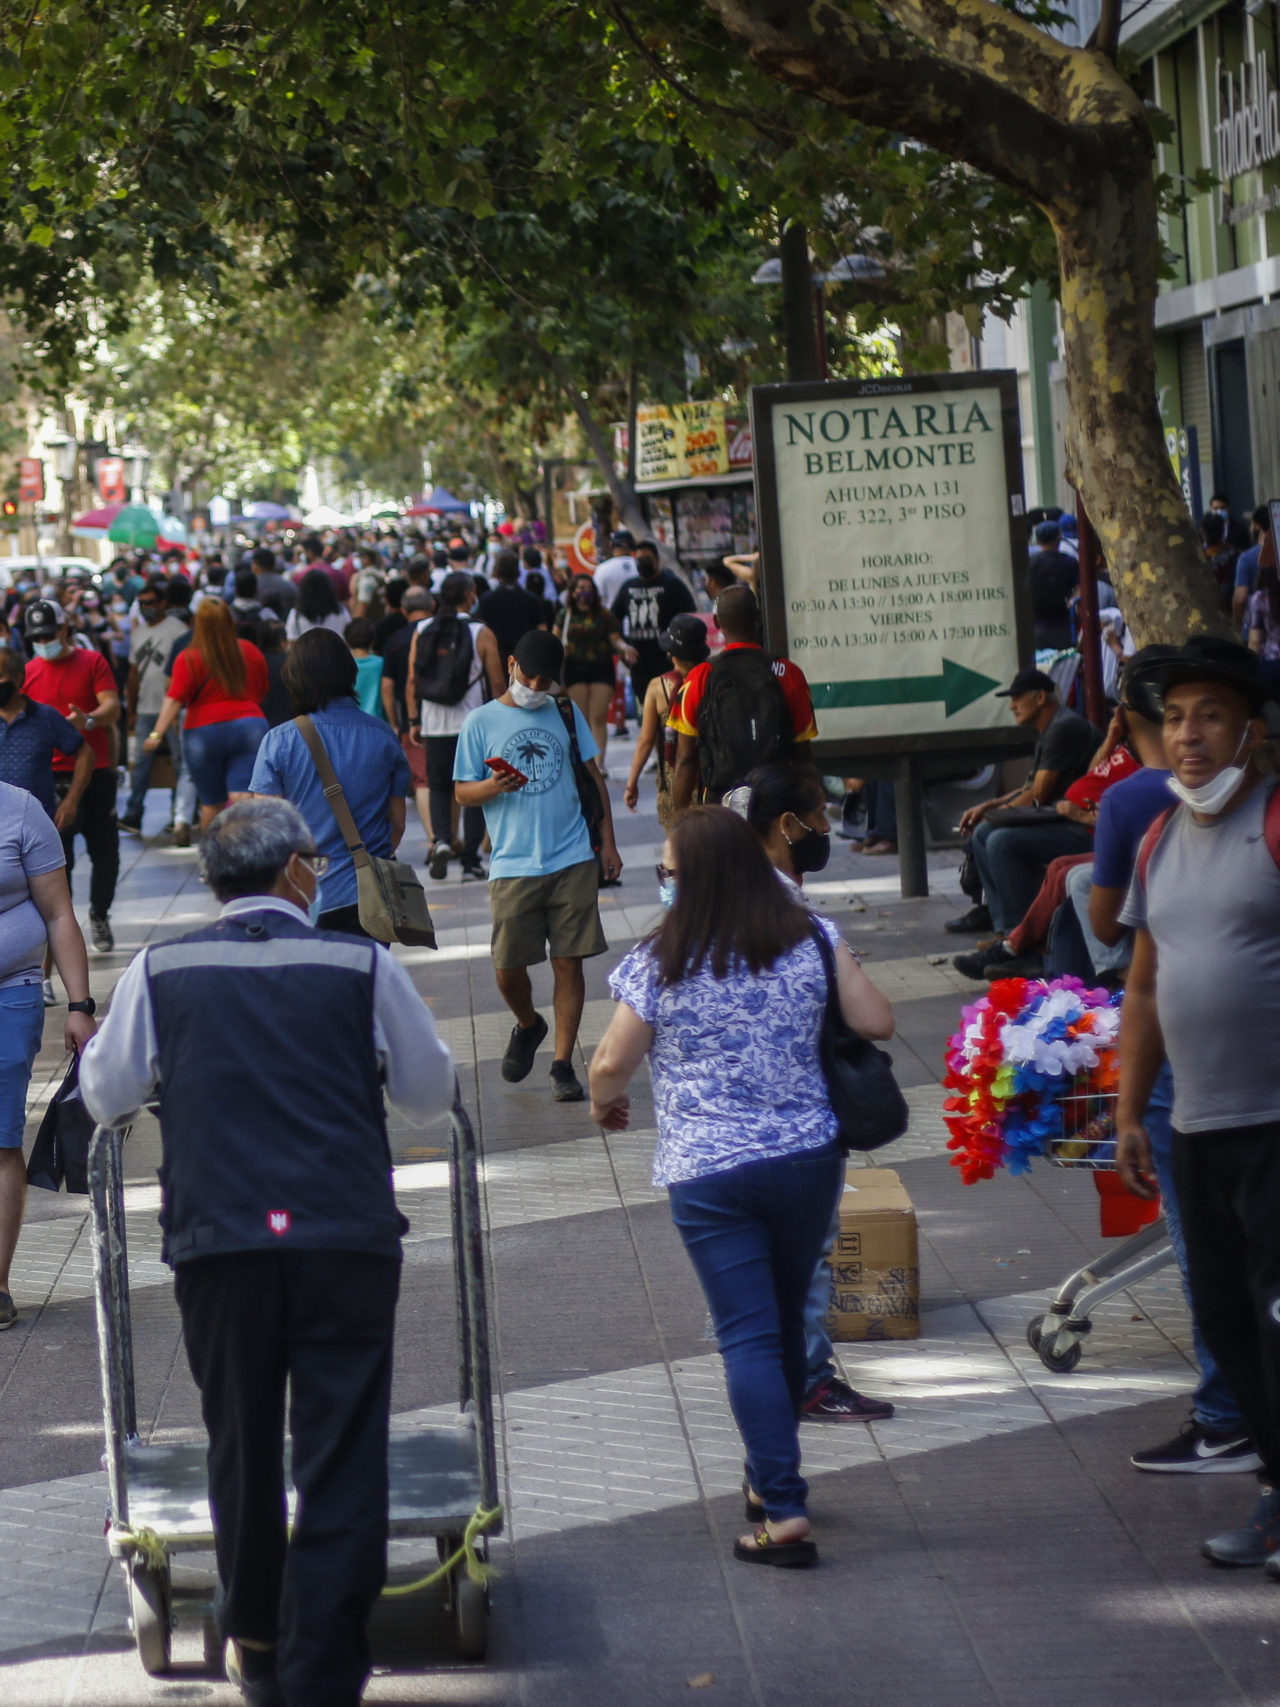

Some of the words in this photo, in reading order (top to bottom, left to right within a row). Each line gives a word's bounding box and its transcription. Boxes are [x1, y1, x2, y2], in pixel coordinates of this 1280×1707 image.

[857, 383, 913, 395] JCDecaux
[782, 399, 995, 446] NOTARIA
[804, 441, 976, 475] BELMONTE
[824, 482, 927, 504] AHUMADA
[933, 479, 961, 496] 131
[822, 510, 852, 527] OF.
[858, 507, 893, 525] 322,
[923, 502, 967, 520] PISO
[862, 551, 933, 568] HORARIO:
[829, 579, 848, 593] DE
[851, 575, 900, 591] LUNES
[903, 575, 913, 588] A
[915, 570, 969, 587] JUEVES
[791, 598, 826, 613] 09:30
[828, 597, 839, 611] A
[842, 595, 875, 610] 13:30
[891, 592, 923, 607] 15:00
[926, 591, 936, 604] A
[940, 588, 973, 604] 18:00
[976, 586, 1008, 601] HRS.
[870, 609, 933, 627] VIERNES
[793, 634, 828, 650] 09:30
[830, 634, 841, 648] A
[844, 631, 878, 648] 13:30
[893, 629, 926, 644] 15:00
[928, 628, 938, 641] A
[942, 625, 975, 641] 17:30
[978, 622, 1011, 638] HRS.
